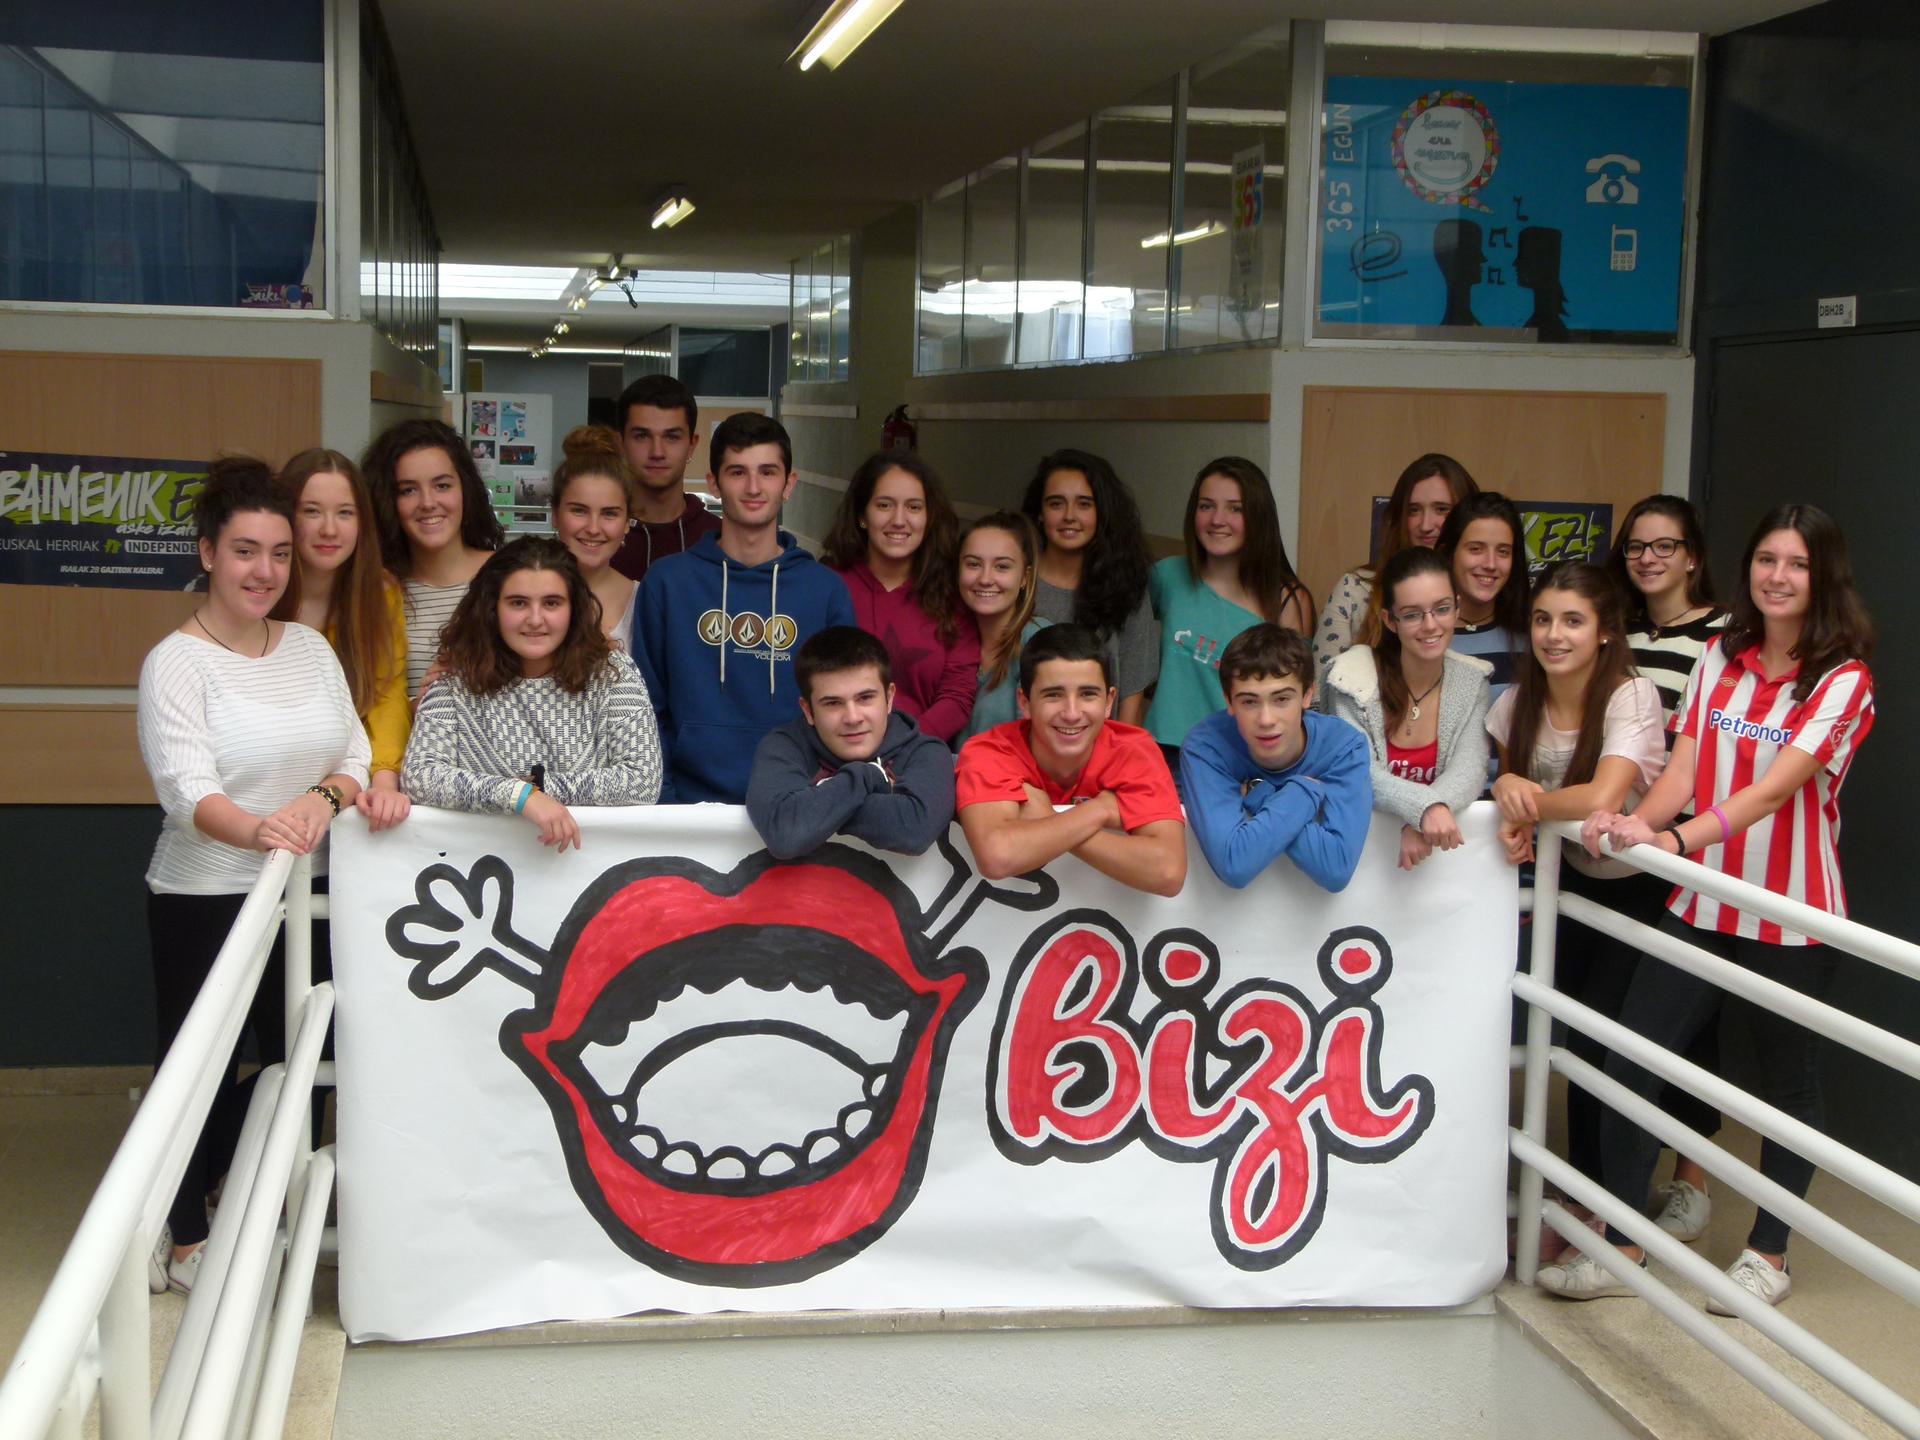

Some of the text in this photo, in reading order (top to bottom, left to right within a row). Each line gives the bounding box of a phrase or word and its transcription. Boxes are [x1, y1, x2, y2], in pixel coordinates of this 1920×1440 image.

[1326, 104, 1354, 232] 365 EGUN
[0, 463, 209, 525] BAIMENIK E
[116, 520, 154, 536] aske
[46, 540, 100, 552] HERRIAK
[128, 541, 197, 553] INDEPENDE
[1709, 709, 1793, 744] Petronor
